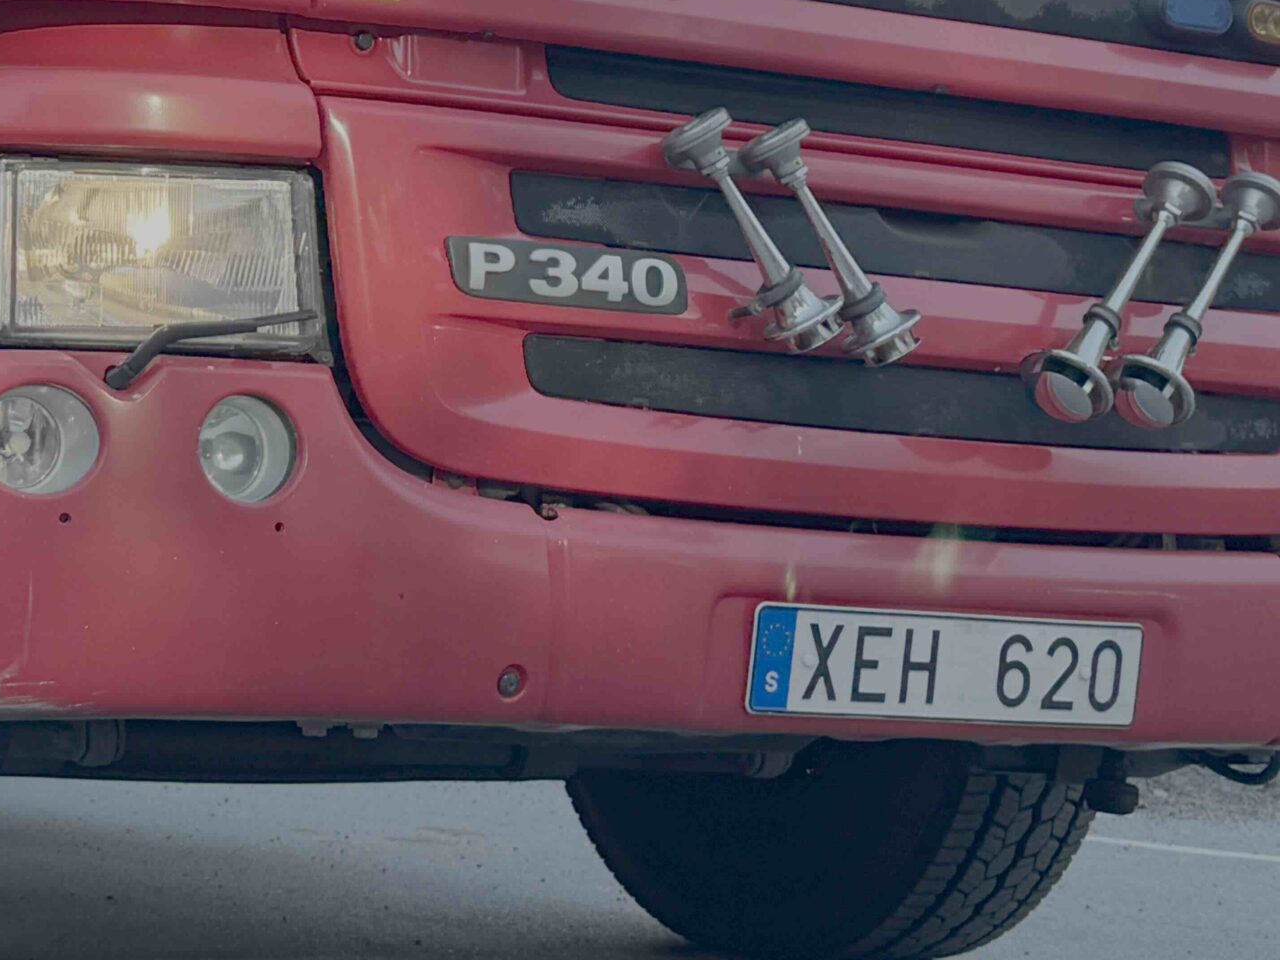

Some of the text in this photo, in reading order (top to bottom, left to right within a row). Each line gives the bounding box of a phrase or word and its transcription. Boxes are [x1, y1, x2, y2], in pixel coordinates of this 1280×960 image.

[468, 242, 679, 307] P 340
[764, 670, 779, 693] S
[801, 623, 1123, 712] XEH 620
